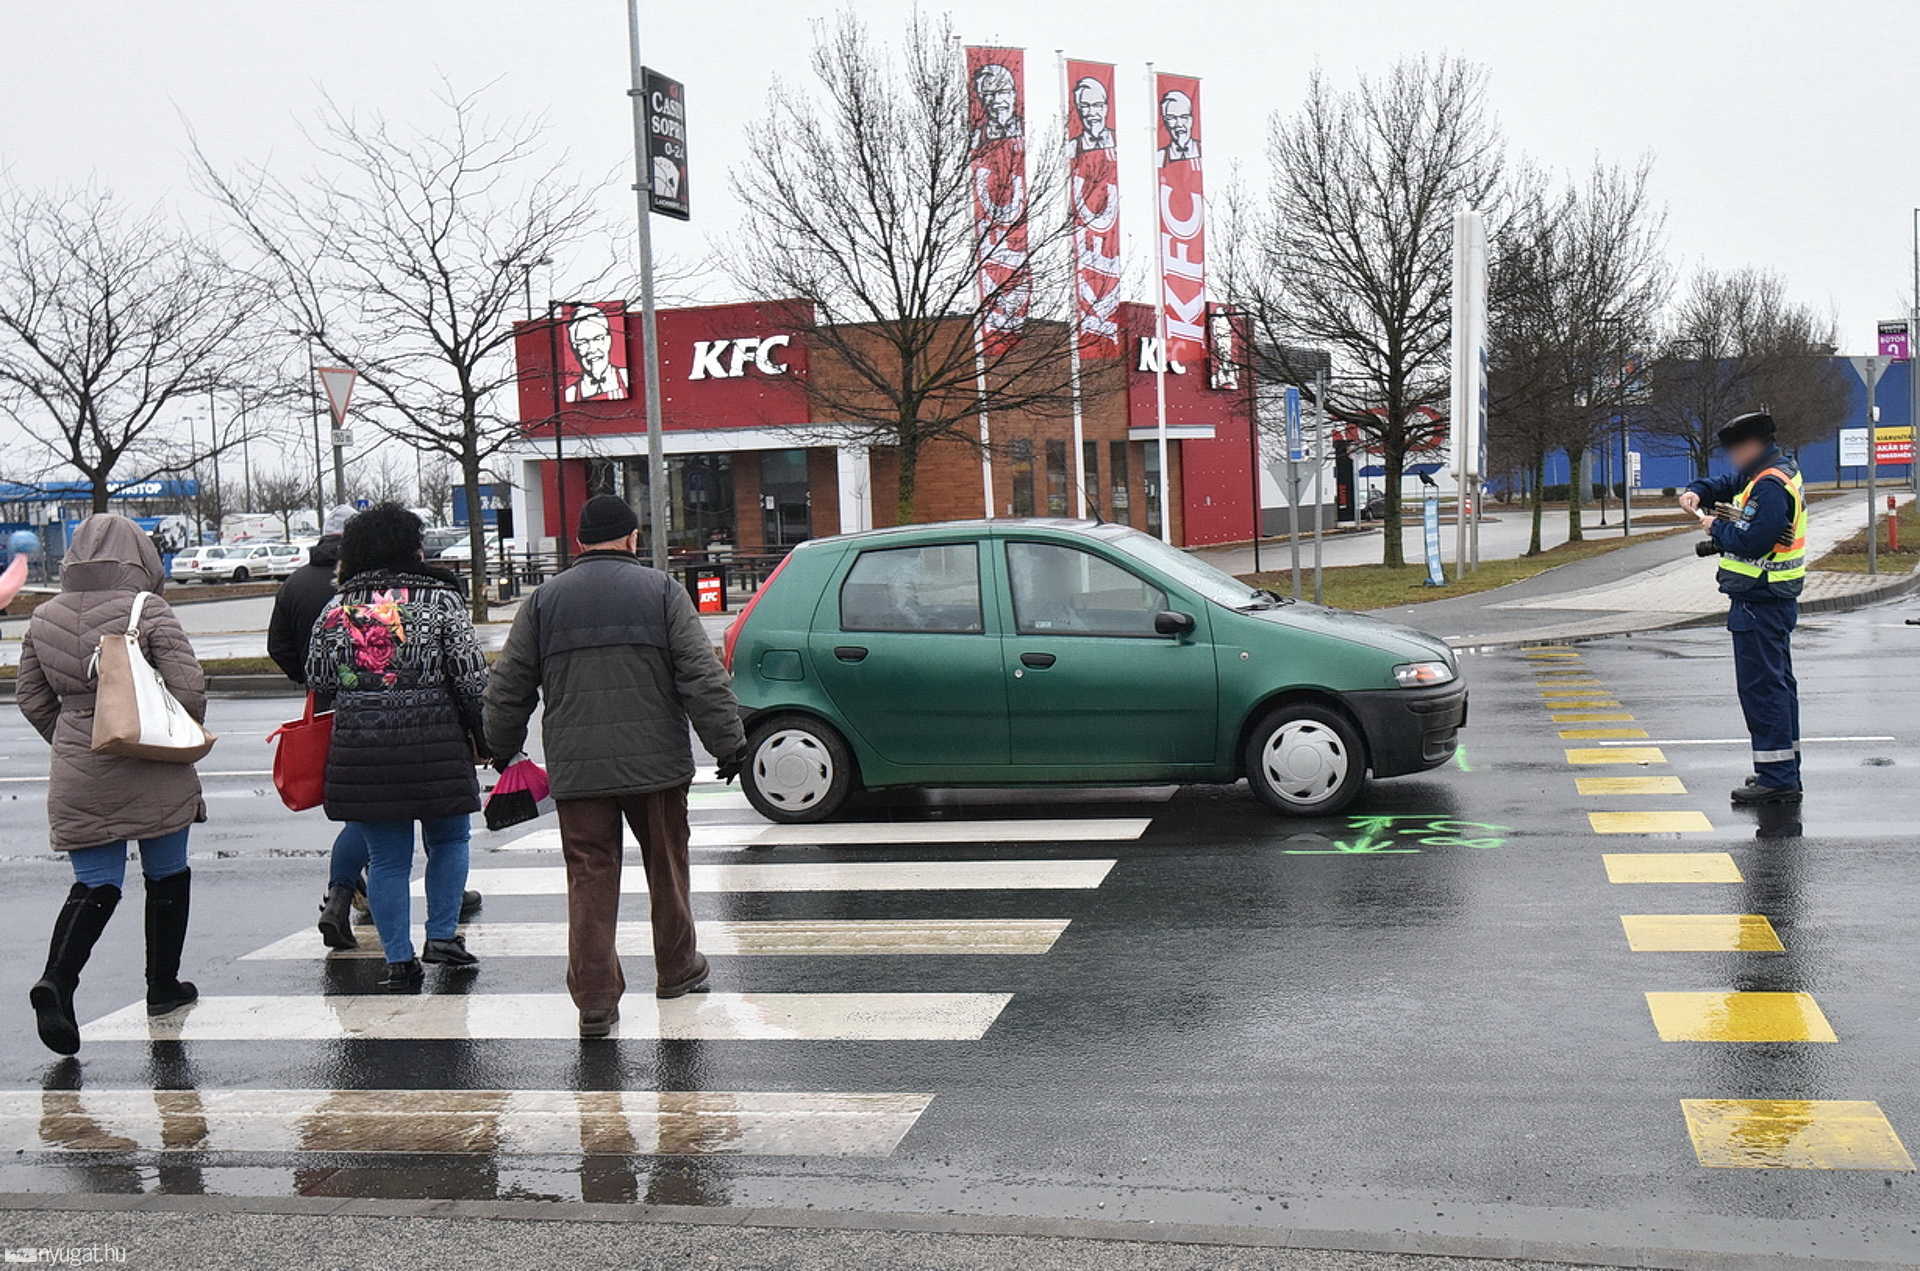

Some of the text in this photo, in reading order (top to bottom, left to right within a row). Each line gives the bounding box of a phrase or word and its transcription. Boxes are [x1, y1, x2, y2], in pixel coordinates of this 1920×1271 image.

[1074, 174, 1119, 344] KFC
[1161, 183, 1206, 345] KFC
[688, 335, 789, 380] KFC
